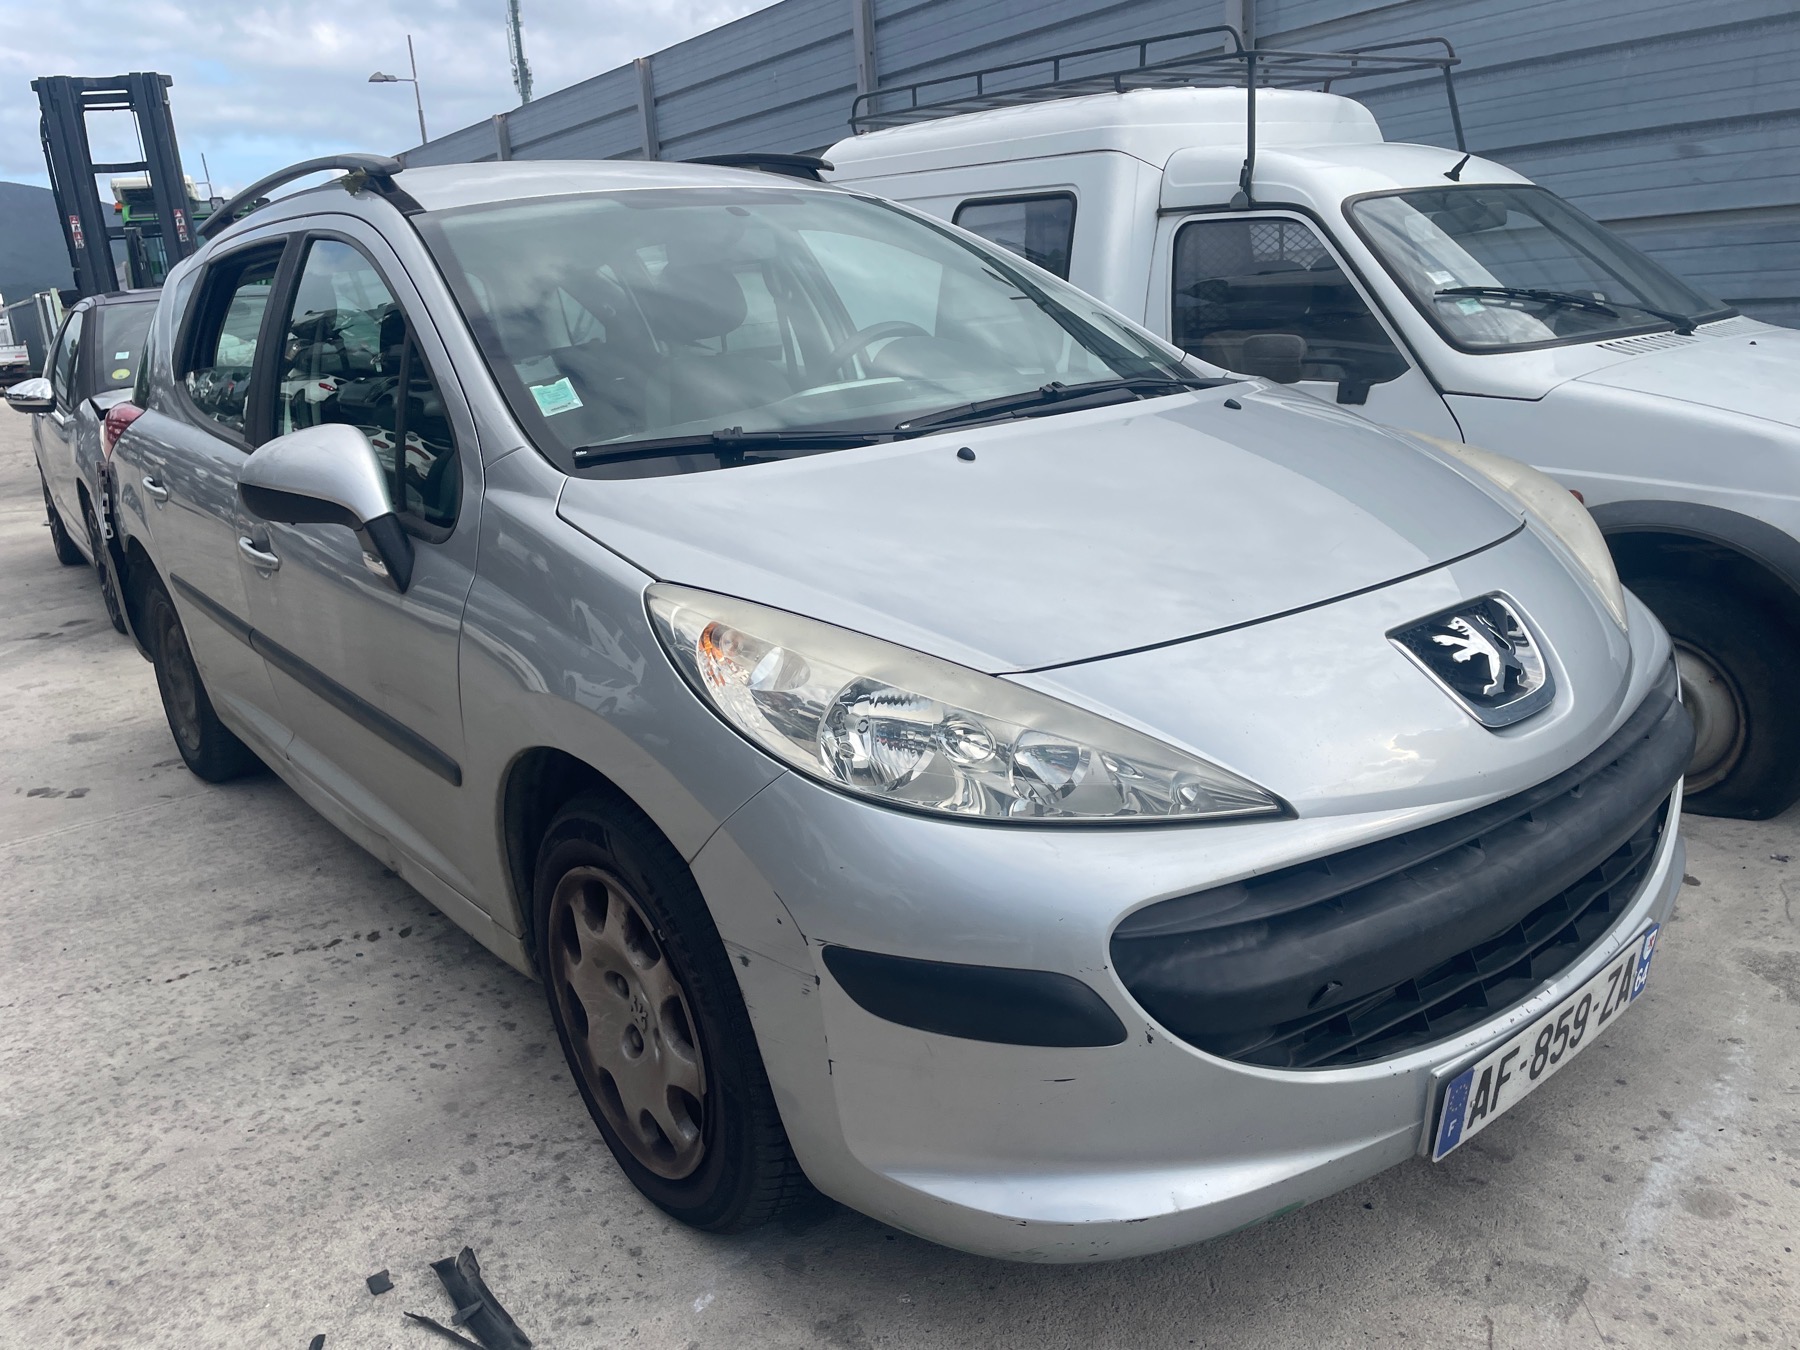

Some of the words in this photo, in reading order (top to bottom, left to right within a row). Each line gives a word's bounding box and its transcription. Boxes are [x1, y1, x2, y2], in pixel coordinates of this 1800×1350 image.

[1634, 961, 1650, 992] 64
[1467, 952, 1637, 1130] AF-859-ZA
[1447, 1118, 1458, 1138] F
